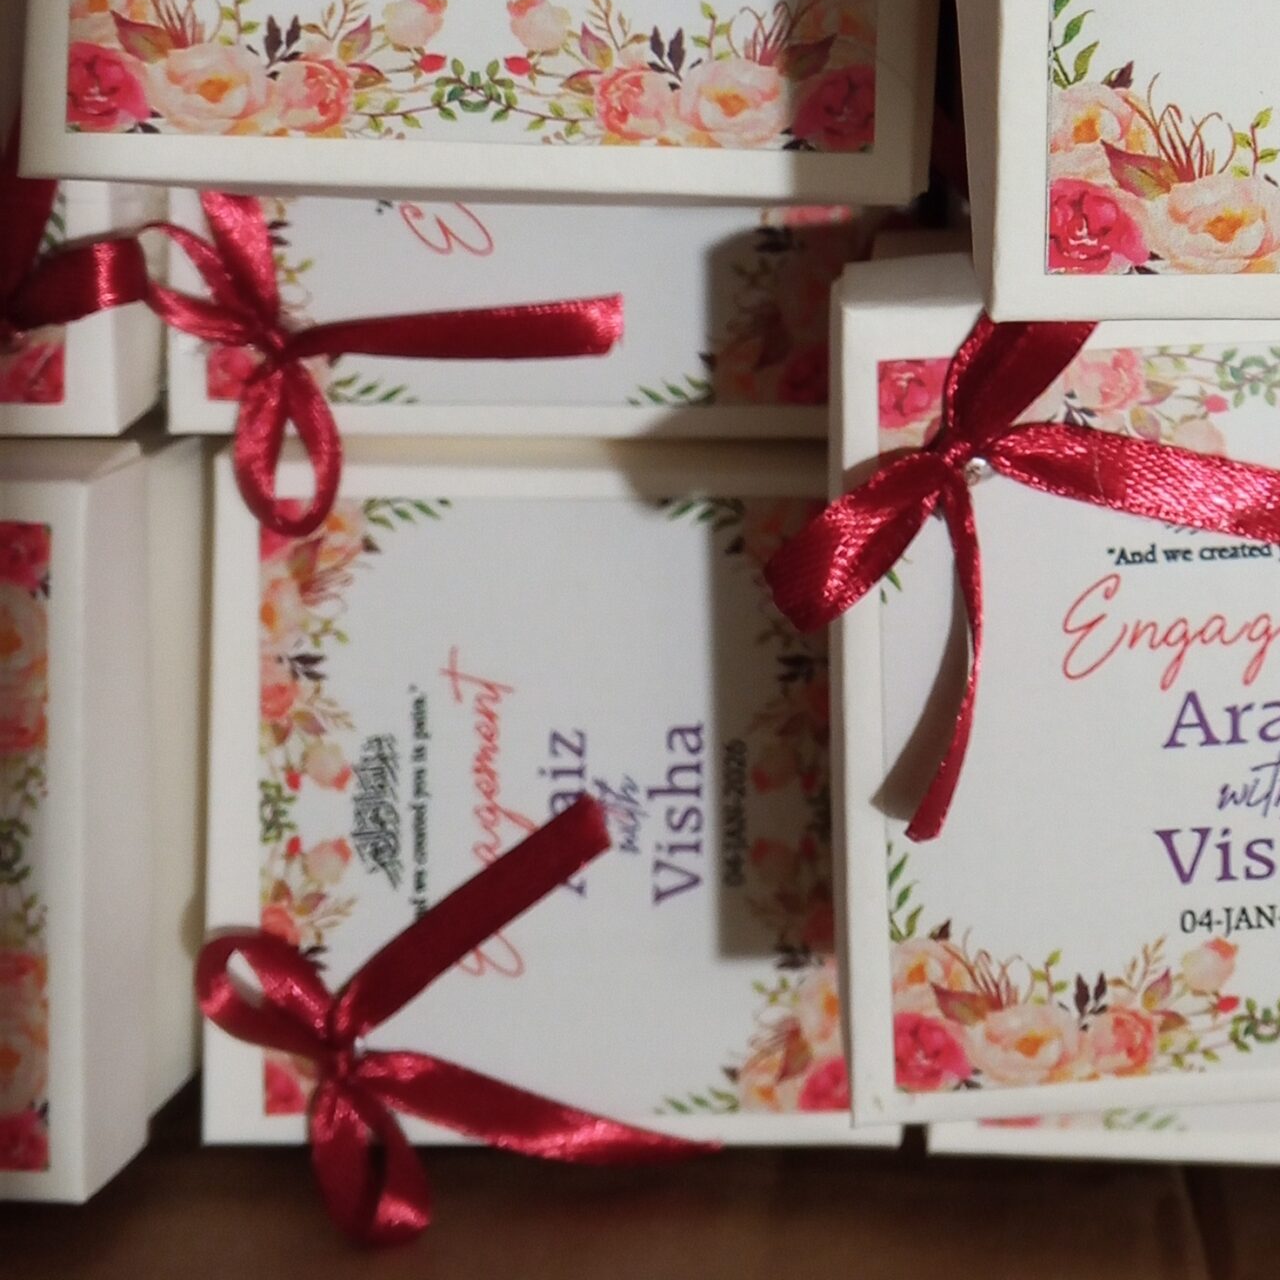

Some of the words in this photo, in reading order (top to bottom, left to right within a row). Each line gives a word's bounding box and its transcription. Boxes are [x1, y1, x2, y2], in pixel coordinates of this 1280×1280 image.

[1107, 544, 1156, 566] "And
[1162, 547, 1193, 562] we
[648, 722, 704, 905] Visha
